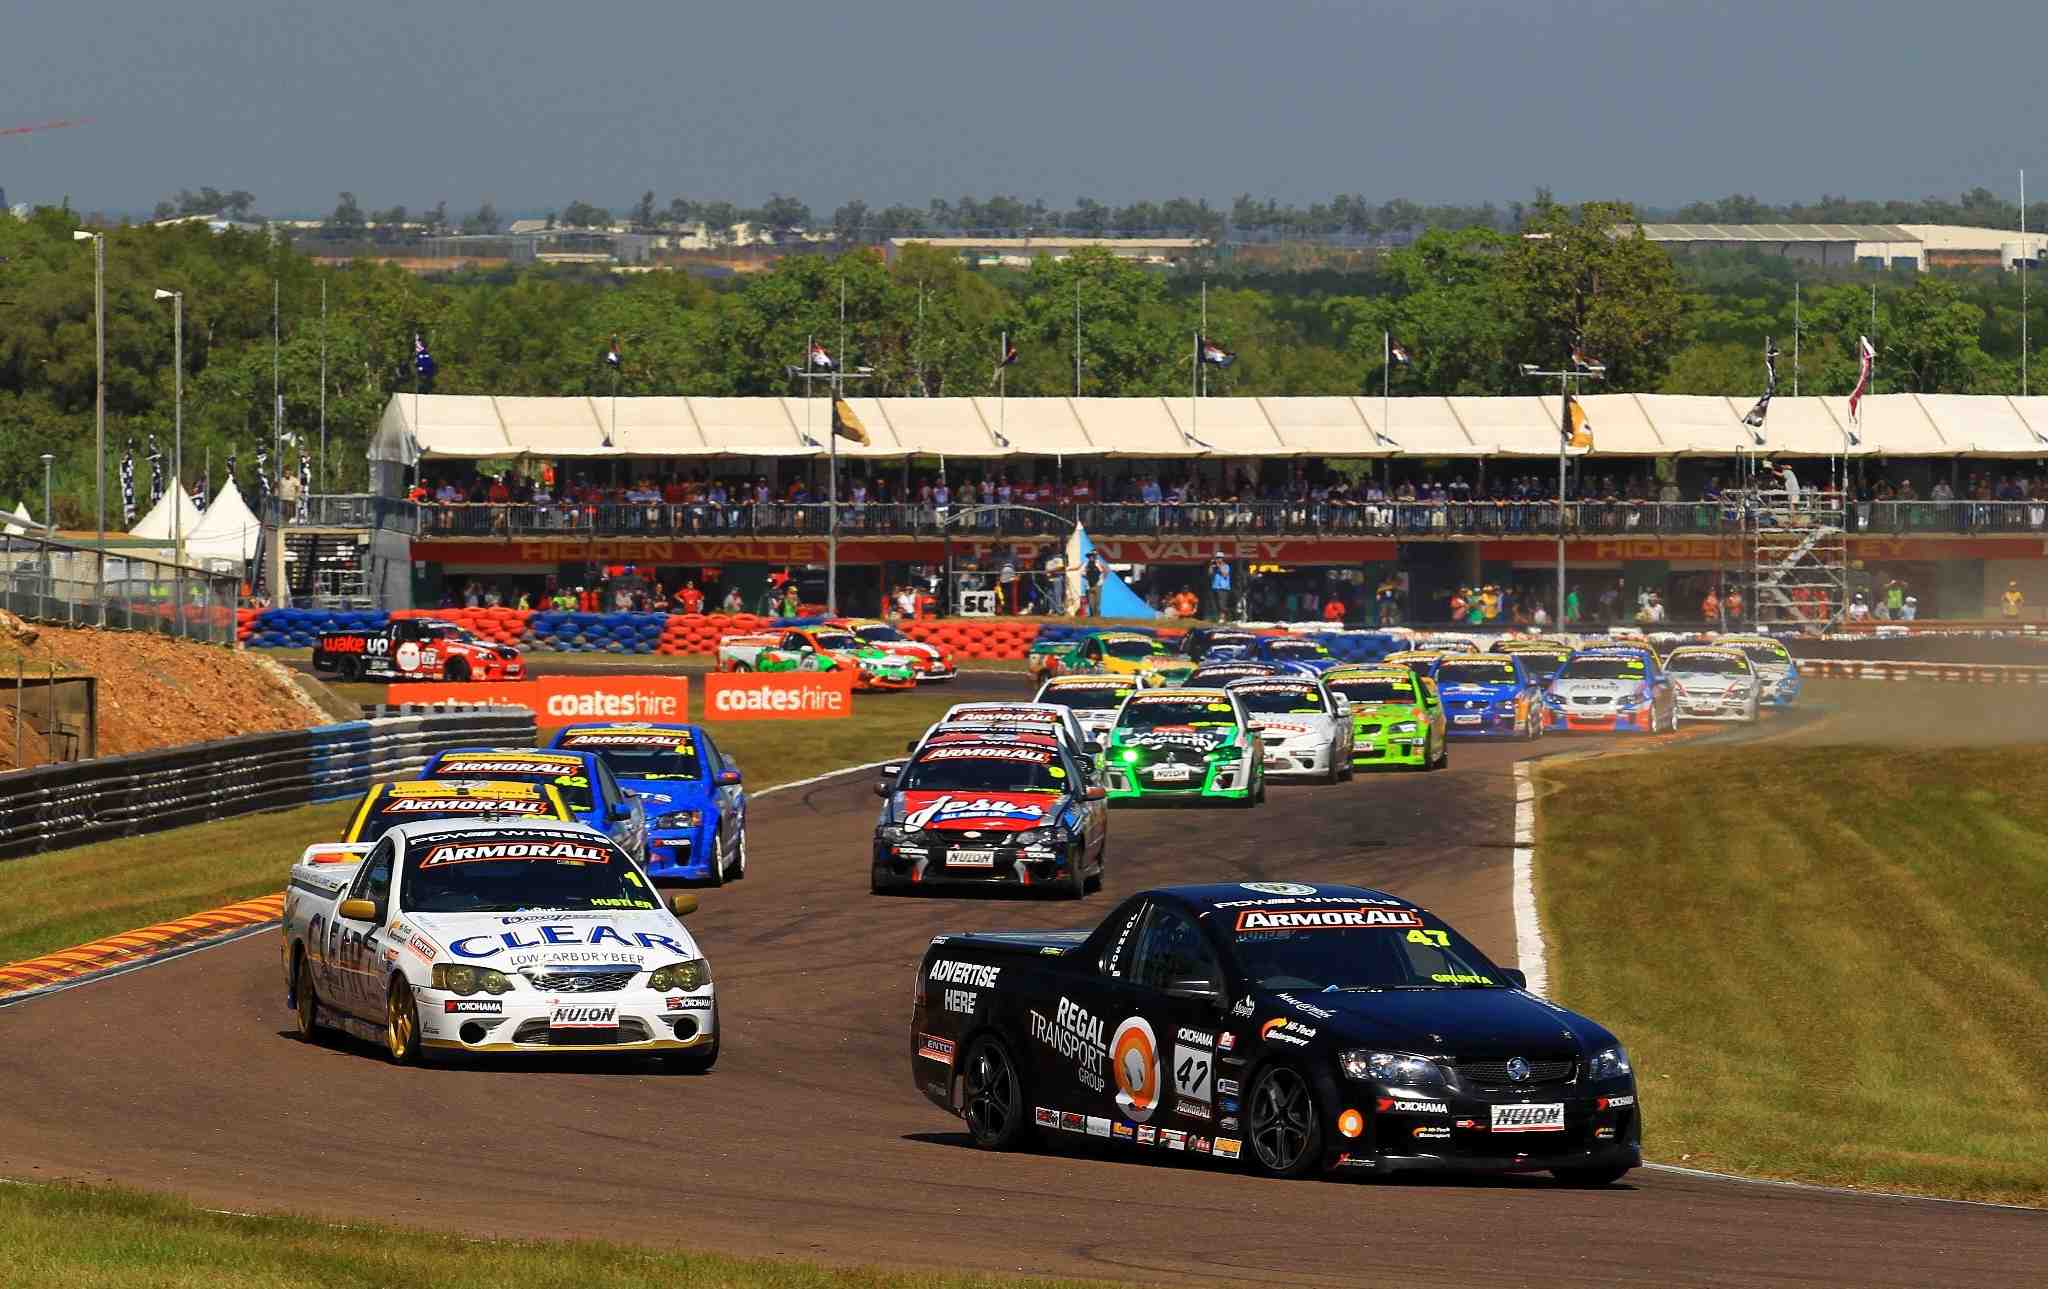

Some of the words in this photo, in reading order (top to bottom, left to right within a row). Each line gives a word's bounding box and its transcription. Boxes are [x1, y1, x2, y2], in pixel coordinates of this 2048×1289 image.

[521, 543, 672, 559] HIDDEN
[1137, 542, 1287, 559] VALLEY
[323, 635, 365, 654] wake
[367, 637, 389, 657] up
[572, 736, 681, 745] ARMORALL
[928, 749, 1046, 762] ARMORALL
[446, 762, 571, 774] ARMORALL
[555, 775, 589, 788] 42
[391, 799, 540, 813] ARMORALL
[904, 796, 1049, 833] Jesus
[430, 843, 606, 865] ARMORALL
[624, 872, 643, 887] 1
[1245, 910, 1417, 929] ARMORALL
[449, 925, 691, 959] CLEAR
[1407, 930, 1451, 946] 47
[510, 953, 538, 966] LOW
[580, 952, 609, 962] DRY
[611, 953, 645, 964] BEER
[929, 959, 1001, 988] ADVERTISE
[456, 1002, 502, 1012] YOKOHAMA
[944, 989, 977, 1014] HERE
[552, 1007, 616, 1022] NULON
[1056, 996, 1106, 1051] REGAL
[1030, 1009, 1106, 1075] TRANSPORT
[1177, 1027, 1214, 1047] YOKOHAMA
[1079, 1067, 1105, 1092] GROUP
[1176, 1056, 1209, 1094] 47
[1394, 1100, 1448, 1114] YOKOHAMA
[1495, 1107, 1562, 1125] NULON
